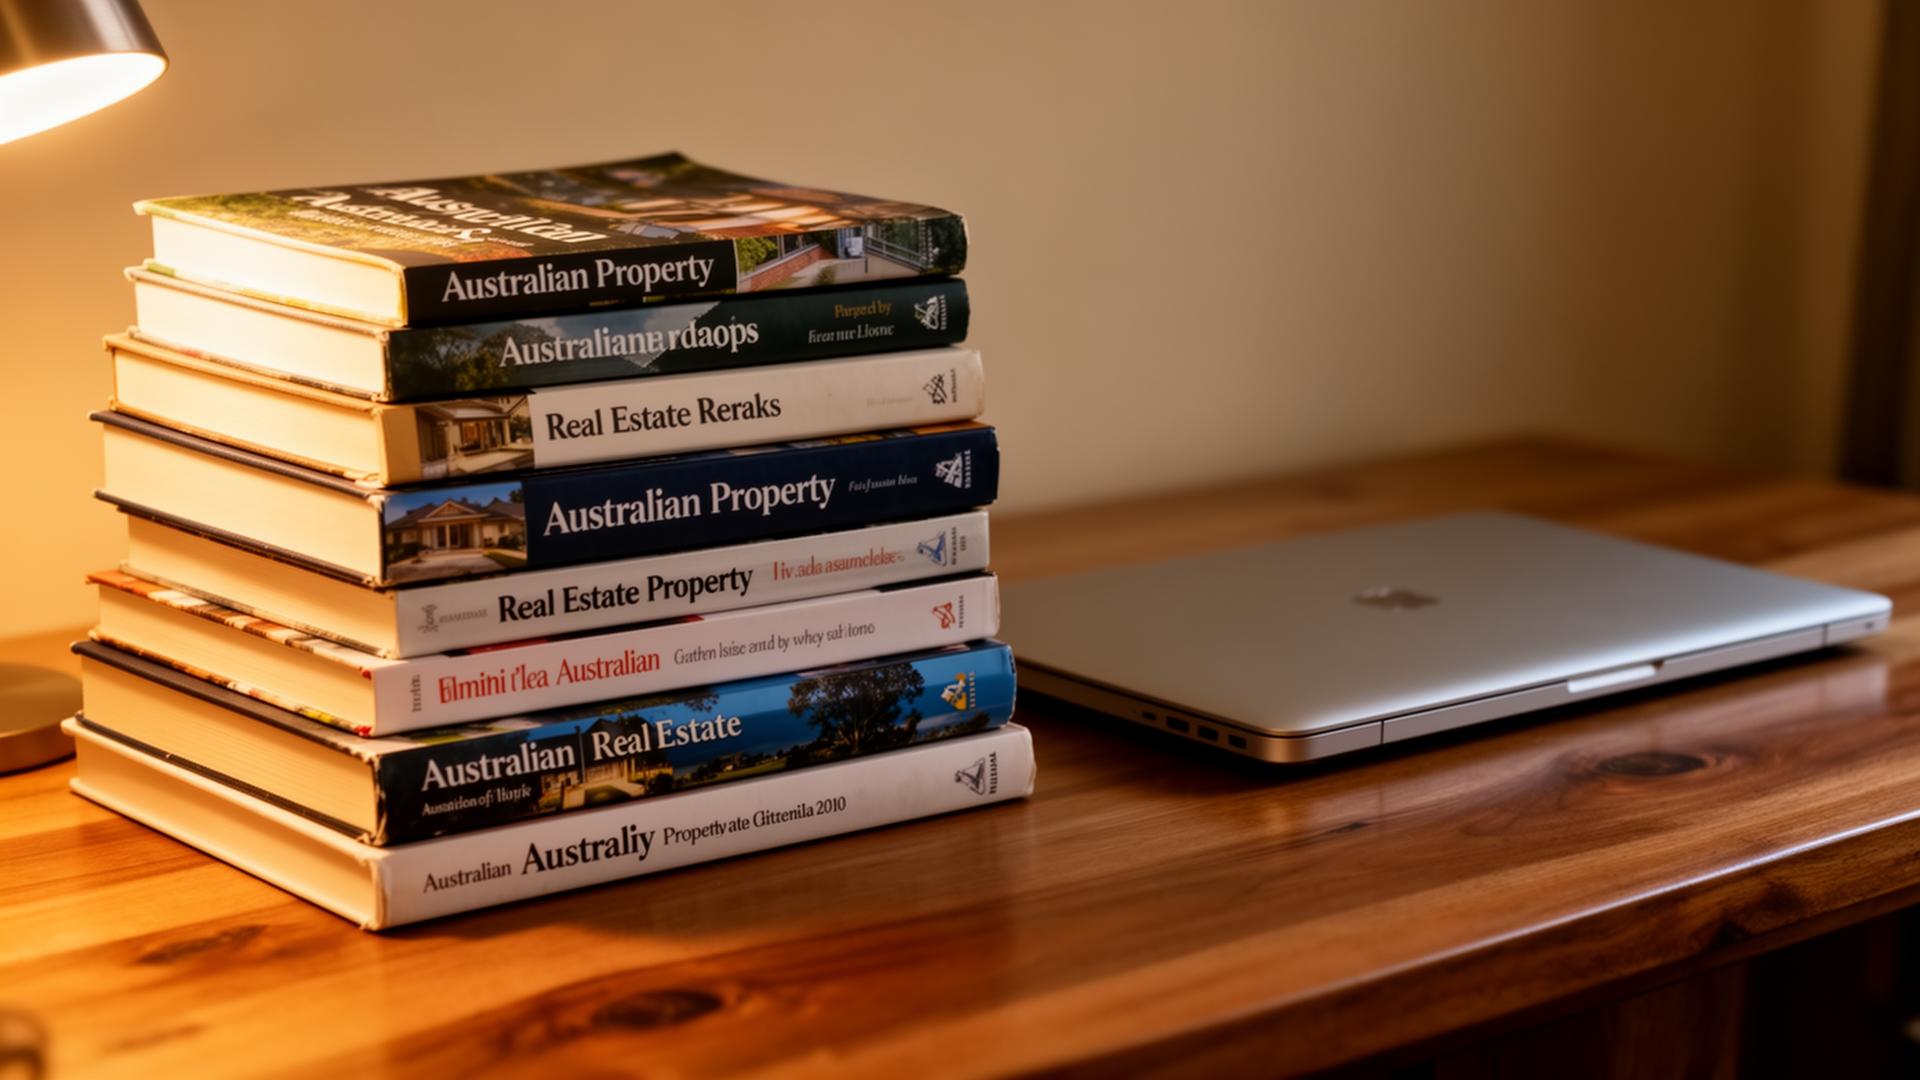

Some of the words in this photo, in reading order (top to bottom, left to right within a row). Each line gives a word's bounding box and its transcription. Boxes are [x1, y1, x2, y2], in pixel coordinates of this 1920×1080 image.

[442, 263, 589, 302] Australian
[595, 254, 715, 292] Property
[546, 408, 604, 441] Real
[610, 404, 691, 434] Estate
[697, 392, 782, 424] Reraks
[543, 488, 700, 536] Australian
[710, 473, 836, 516] Property
[498, 589, 554, 622] Real
[563, 581, 639, 614] Estate
[647, 567, 754, 603] Property
[556, 650, 660, 685] Australian
[777, 635, 790, 652] by
[421, 741, 575, 792] Australian
[592, 723, 651, 762] Real
[656, 713, 742, 750] Estate
[423, 860, 512, 894] Australian
[521, 824, 656, 875] Australiy
[816, 796, 847, 816] 2010
